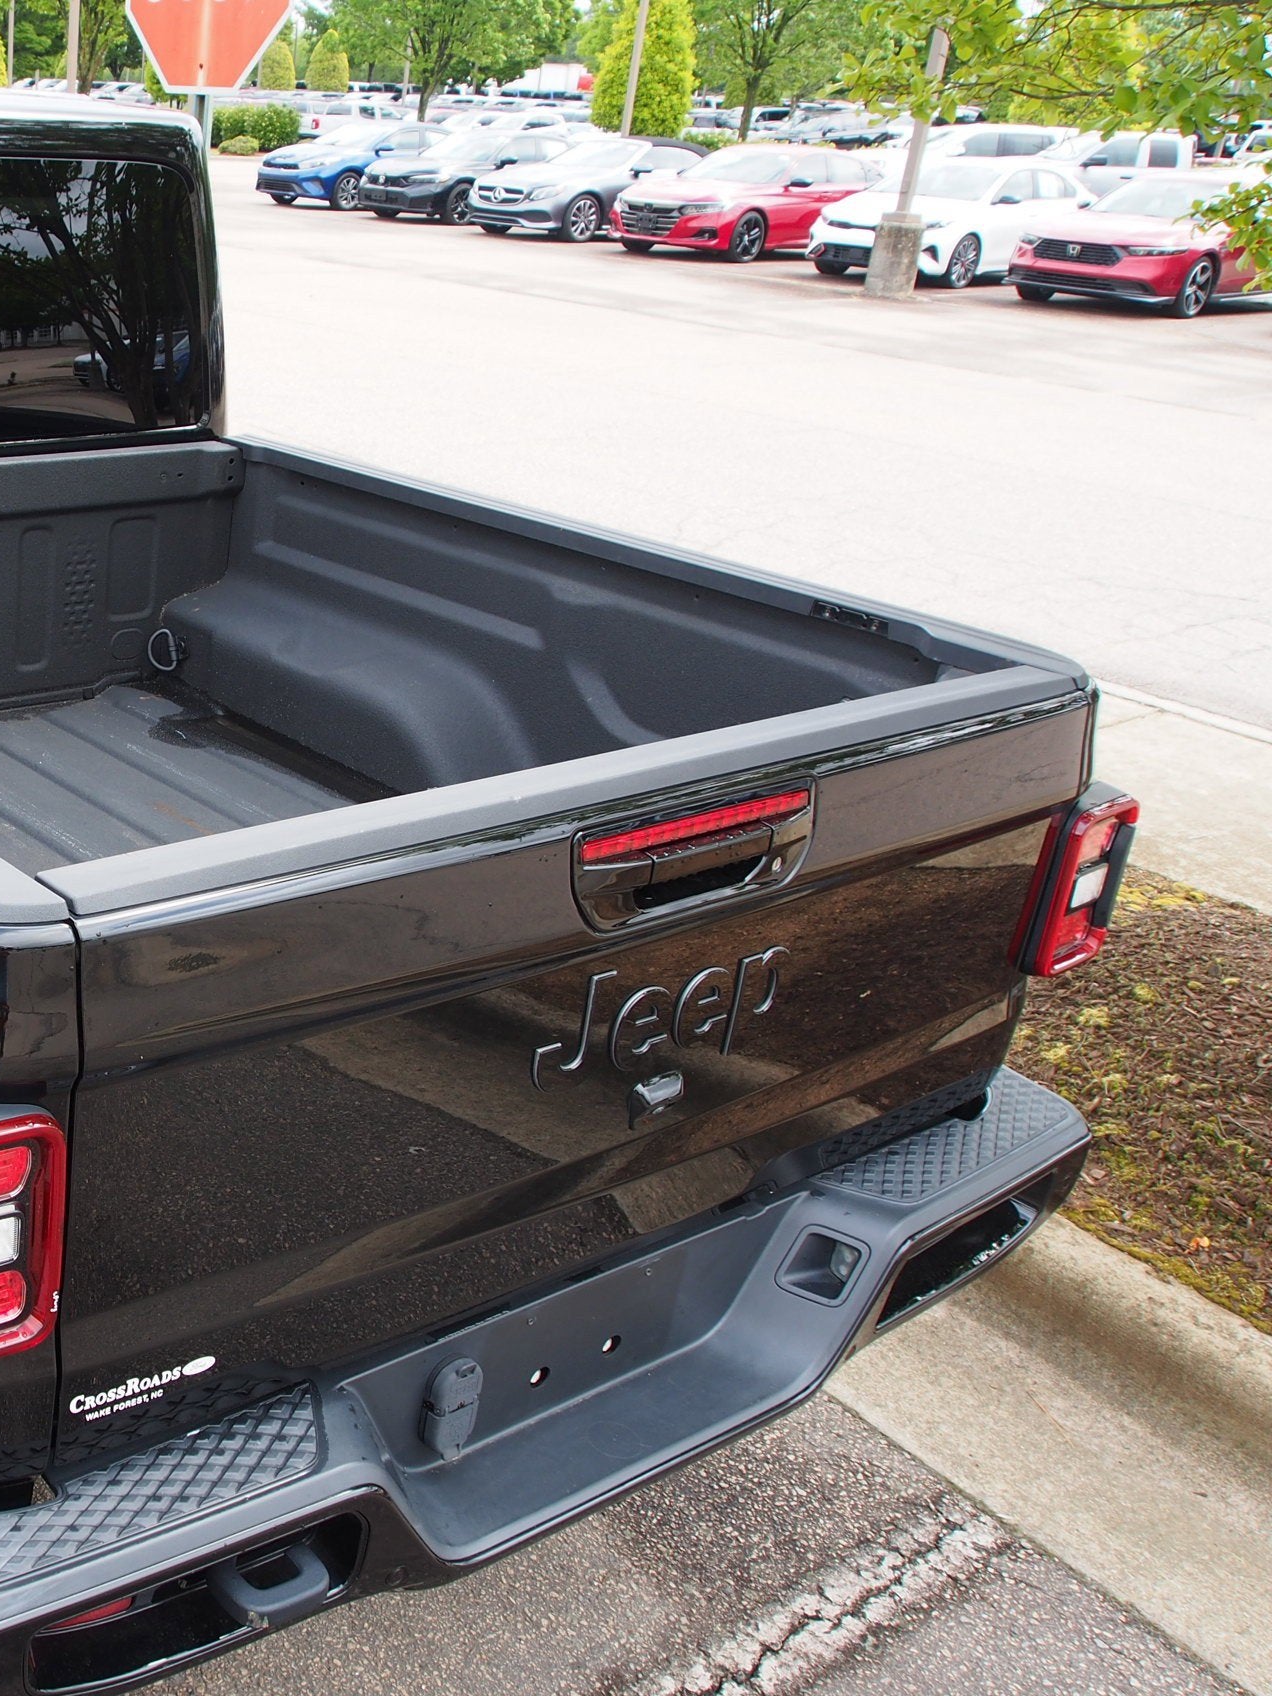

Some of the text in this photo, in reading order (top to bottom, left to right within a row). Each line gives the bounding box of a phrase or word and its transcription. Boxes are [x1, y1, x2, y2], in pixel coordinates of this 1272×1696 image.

[531, 945, 791, 1095] Jeep
[85, 1389, 164, 1422] WAKE FOREST, NC
